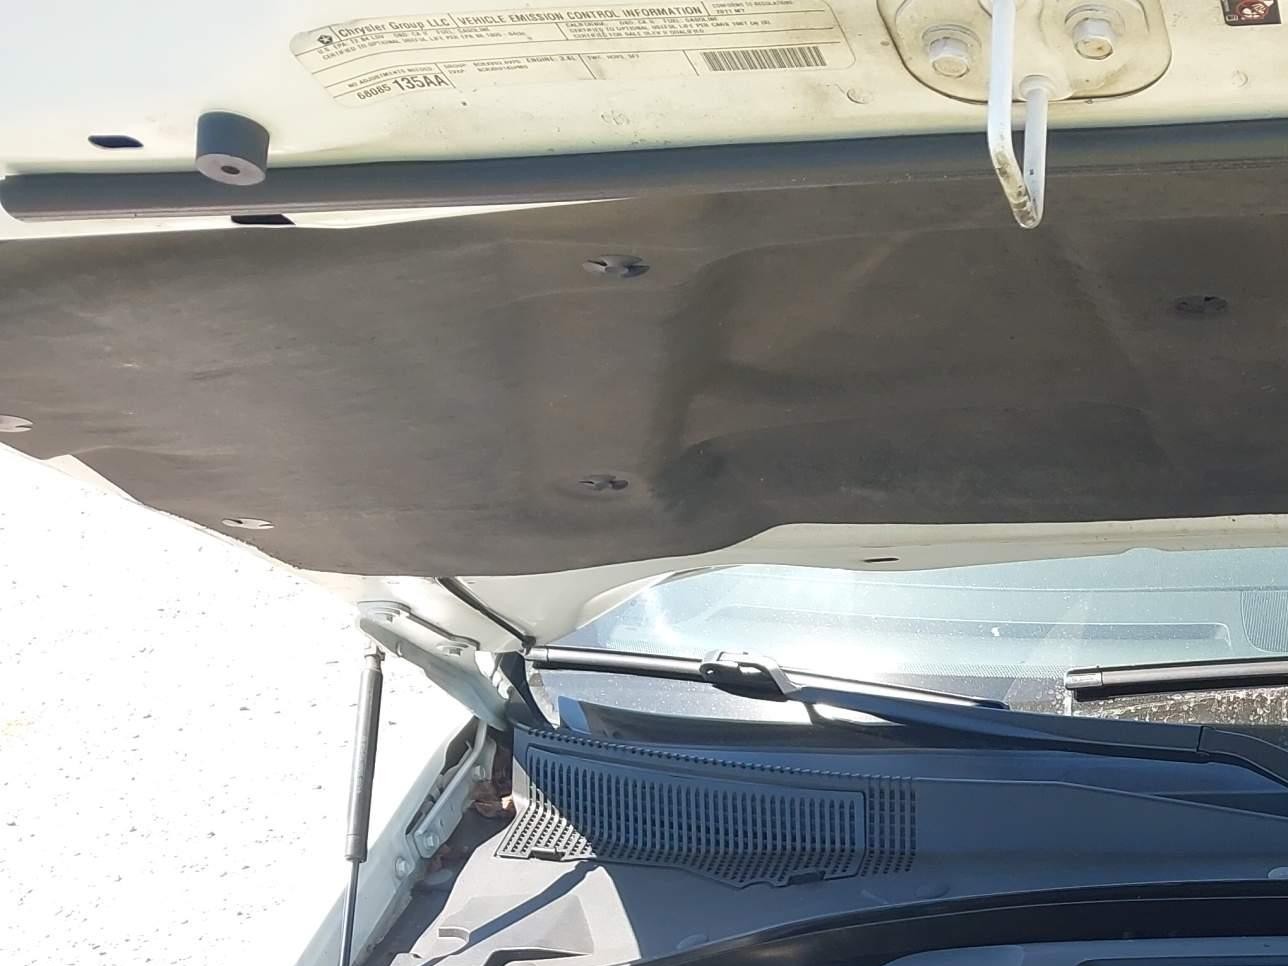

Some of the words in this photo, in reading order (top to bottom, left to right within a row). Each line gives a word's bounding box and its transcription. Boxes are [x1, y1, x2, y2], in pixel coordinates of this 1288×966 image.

[457, 14, 507, 25] VEHICLE
[509, 11, 564, 23] EMISSION
[566, 8, 620, 20] CONTROL
[622, 6, 703, 18] INFORMATION
[338, 23, 387, 38] Chrysler
[388, 20, 425, 32] Group
[427, 17, 451, 28] LLC
[357, 83, 392, 100] 68085
[392, 74, 449, 91] 135AA
